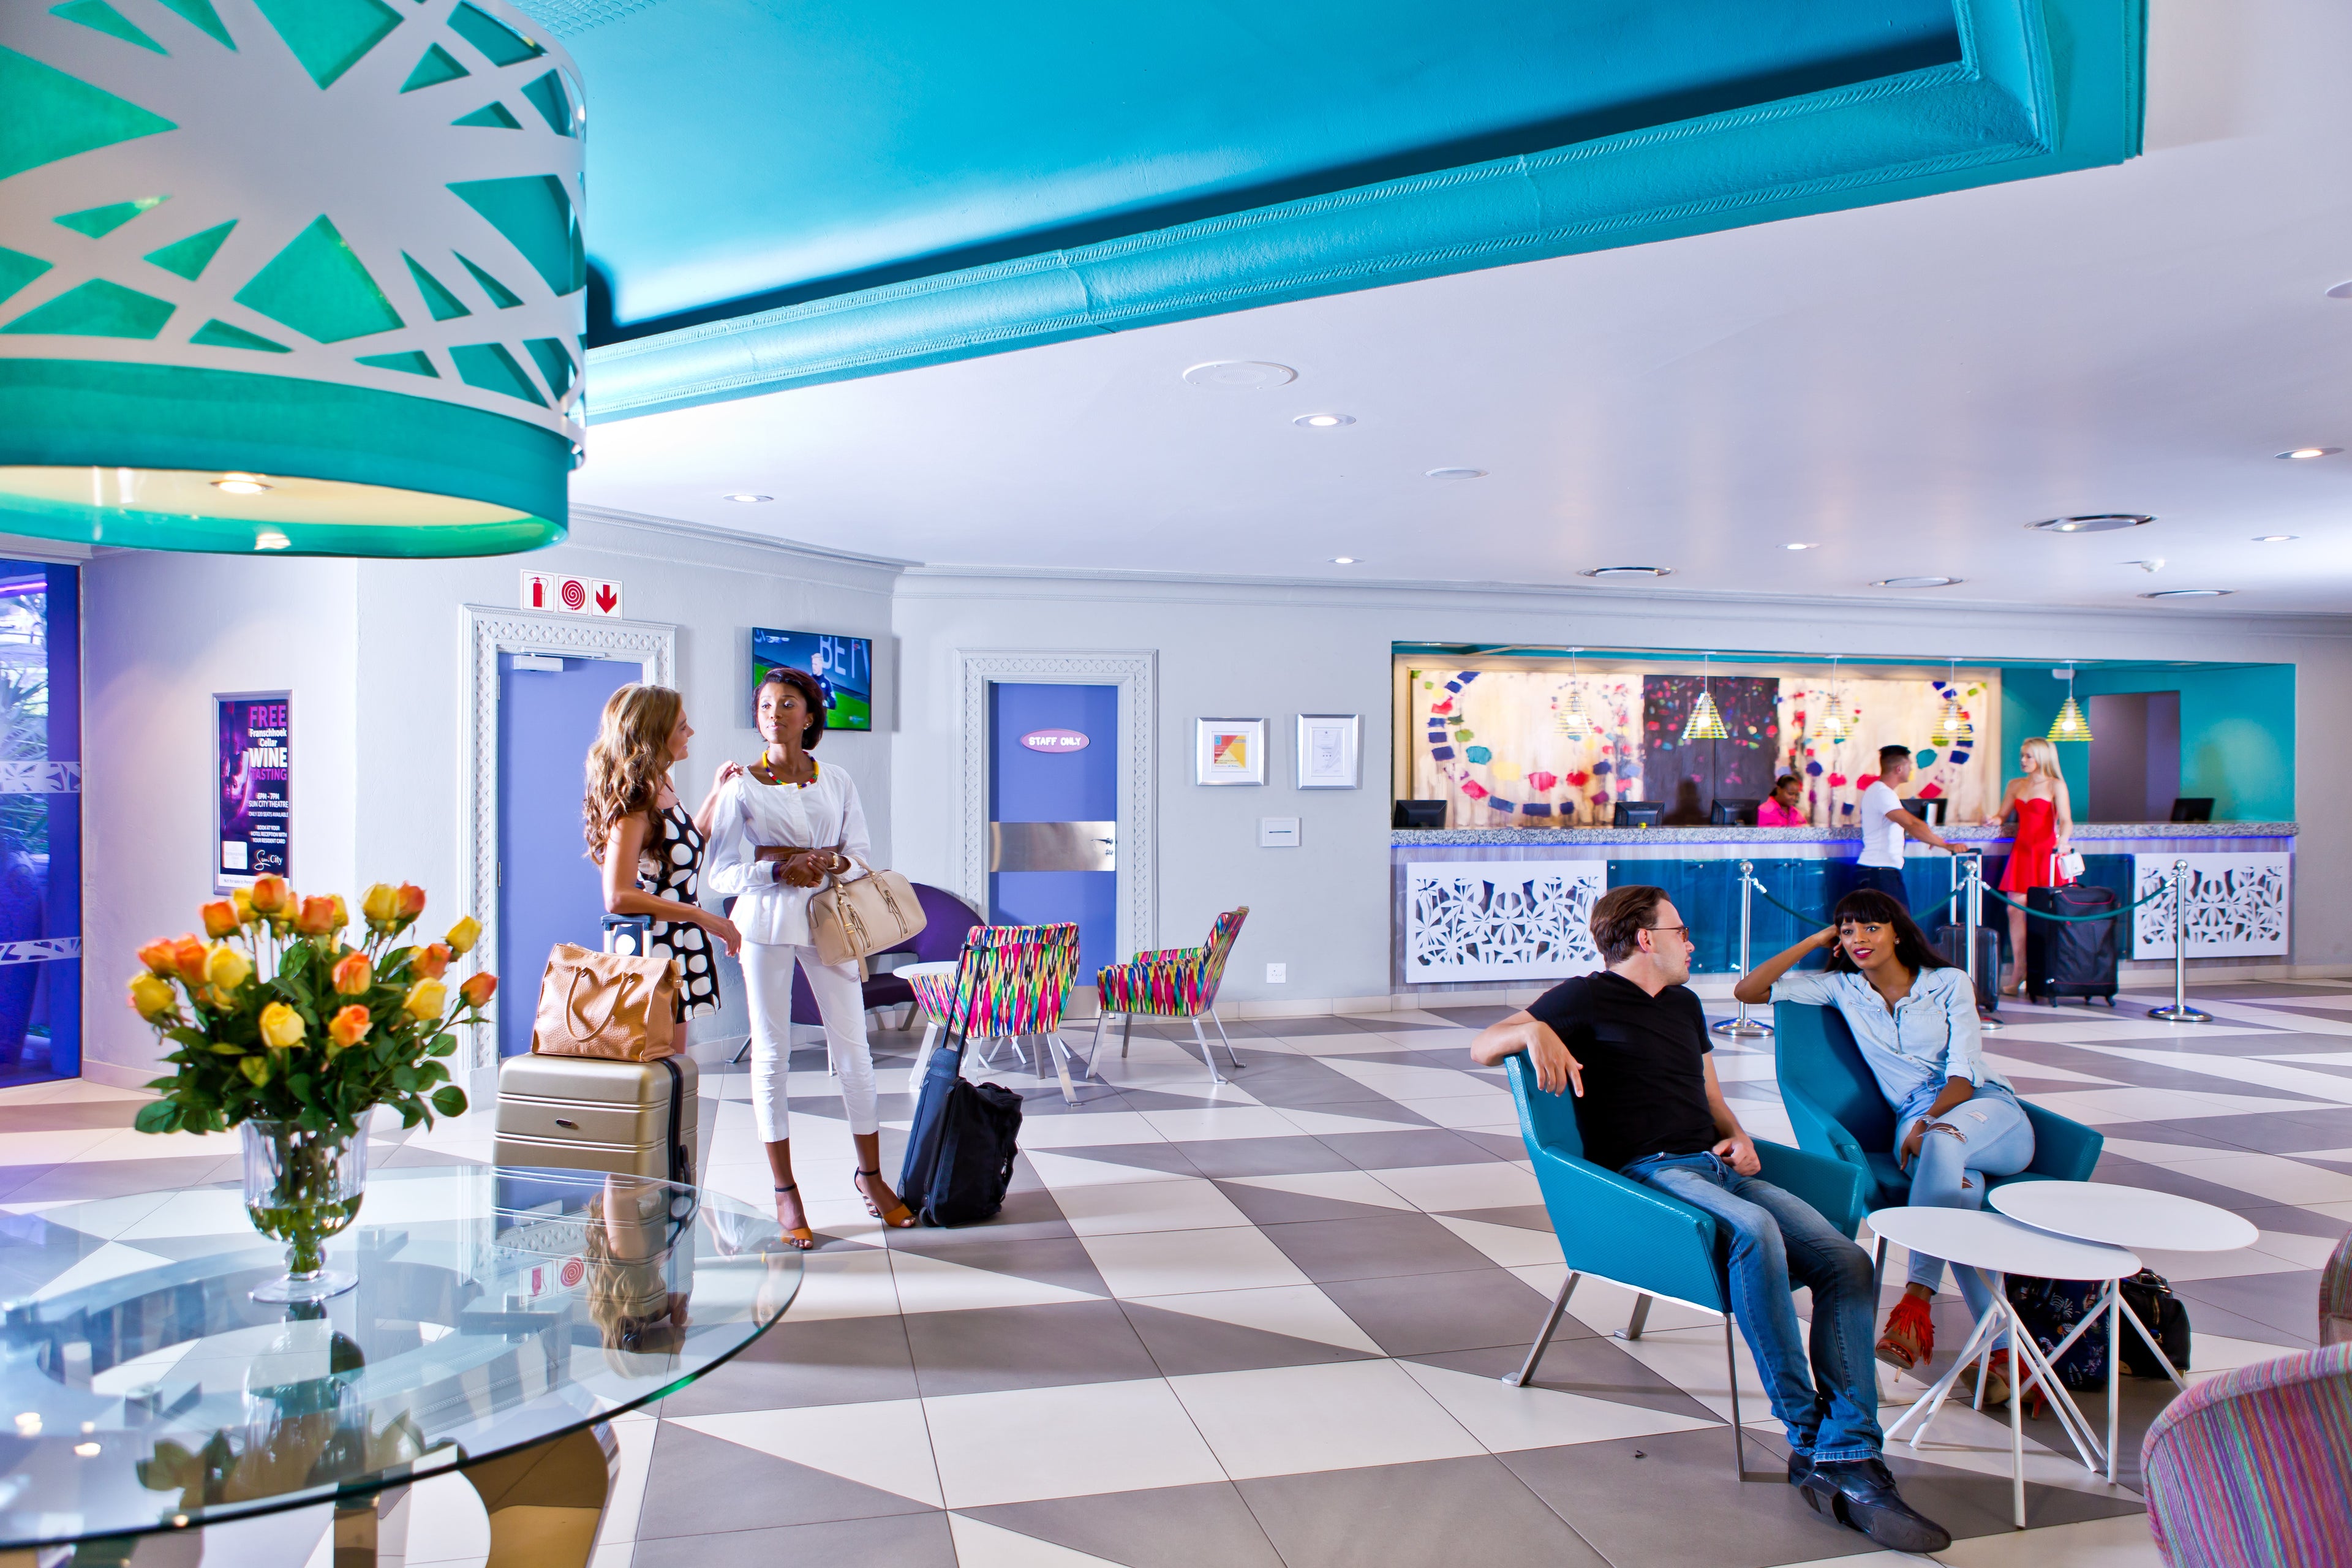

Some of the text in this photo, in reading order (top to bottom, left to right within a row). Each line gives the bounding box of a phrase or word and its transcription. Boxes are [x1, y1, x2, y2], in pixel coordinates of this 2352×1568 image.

[249, 706, 287, 727] FREE
[249, 728, 287, 737] Franschhoek
[258, 738, 277, 747] Cellar
[1029, 737, 1081, 746] STAFF ONLY
[248, 747, 288, 767] WINE
[251, 768, 287, 780] TASTING
[270, 855, 282, 865] City
